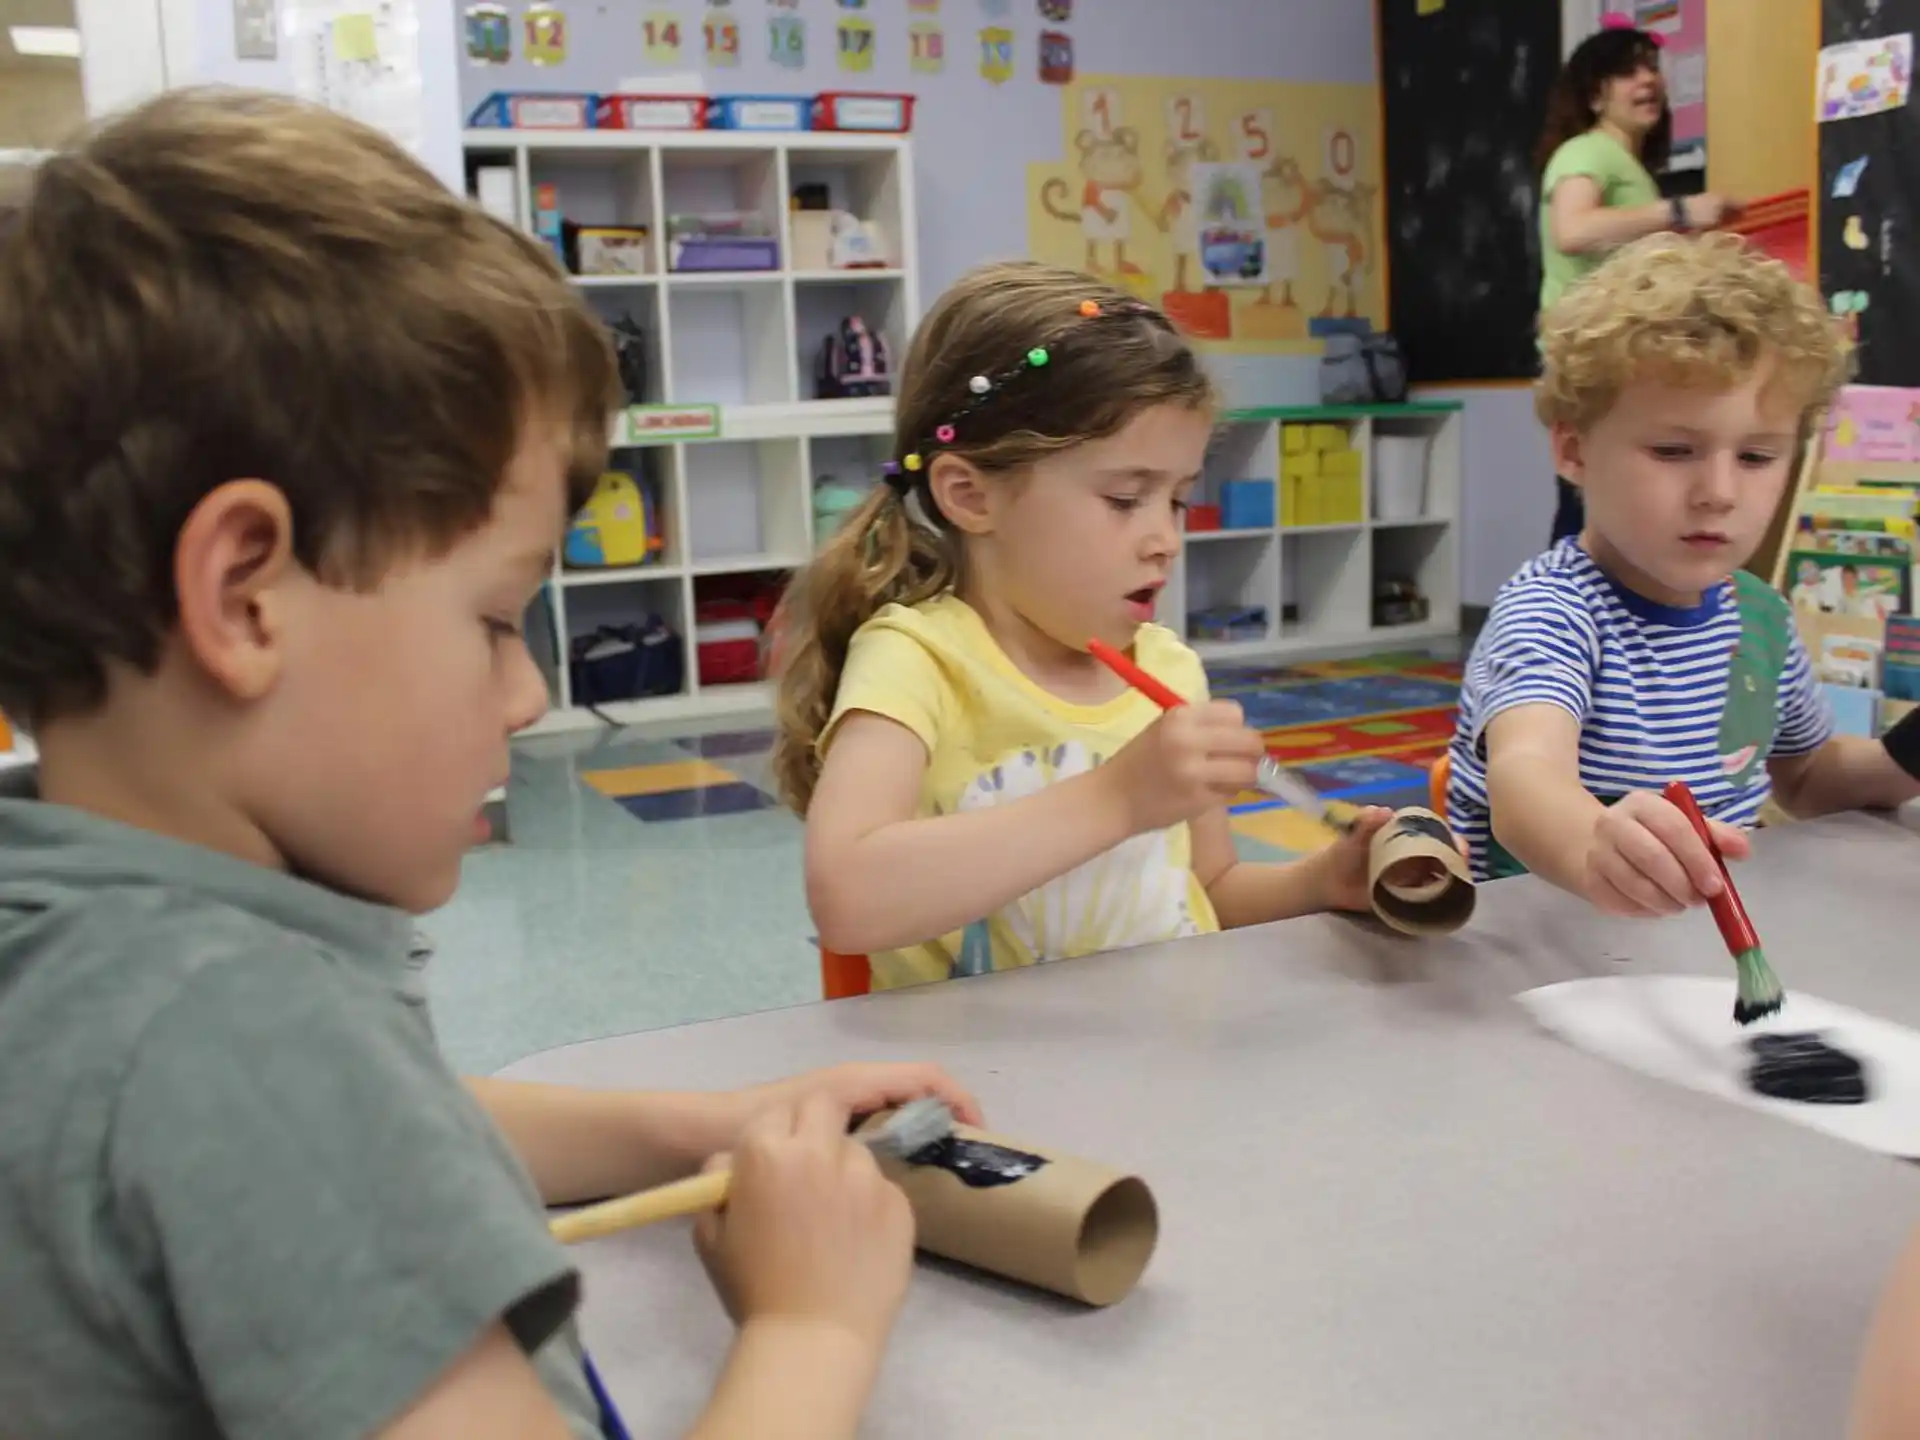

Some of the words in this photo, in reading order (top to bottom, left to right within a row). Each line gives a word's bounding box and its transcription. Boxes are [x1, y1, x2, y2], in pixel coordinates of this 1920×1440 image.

[523, 19, 564, 47] 12
[642, 20, 681, 48] 14
[703, 23, 738, 53] 15
[769, 24, 804, 52] 16
[837, 27, 872, 54] 17
[1092, 92, 1111, 134] 1
[1175, 97, 1201, 139] 2
[1242, 113, 1269, 158] 5
[1330, 131, 1355, 176] 0
